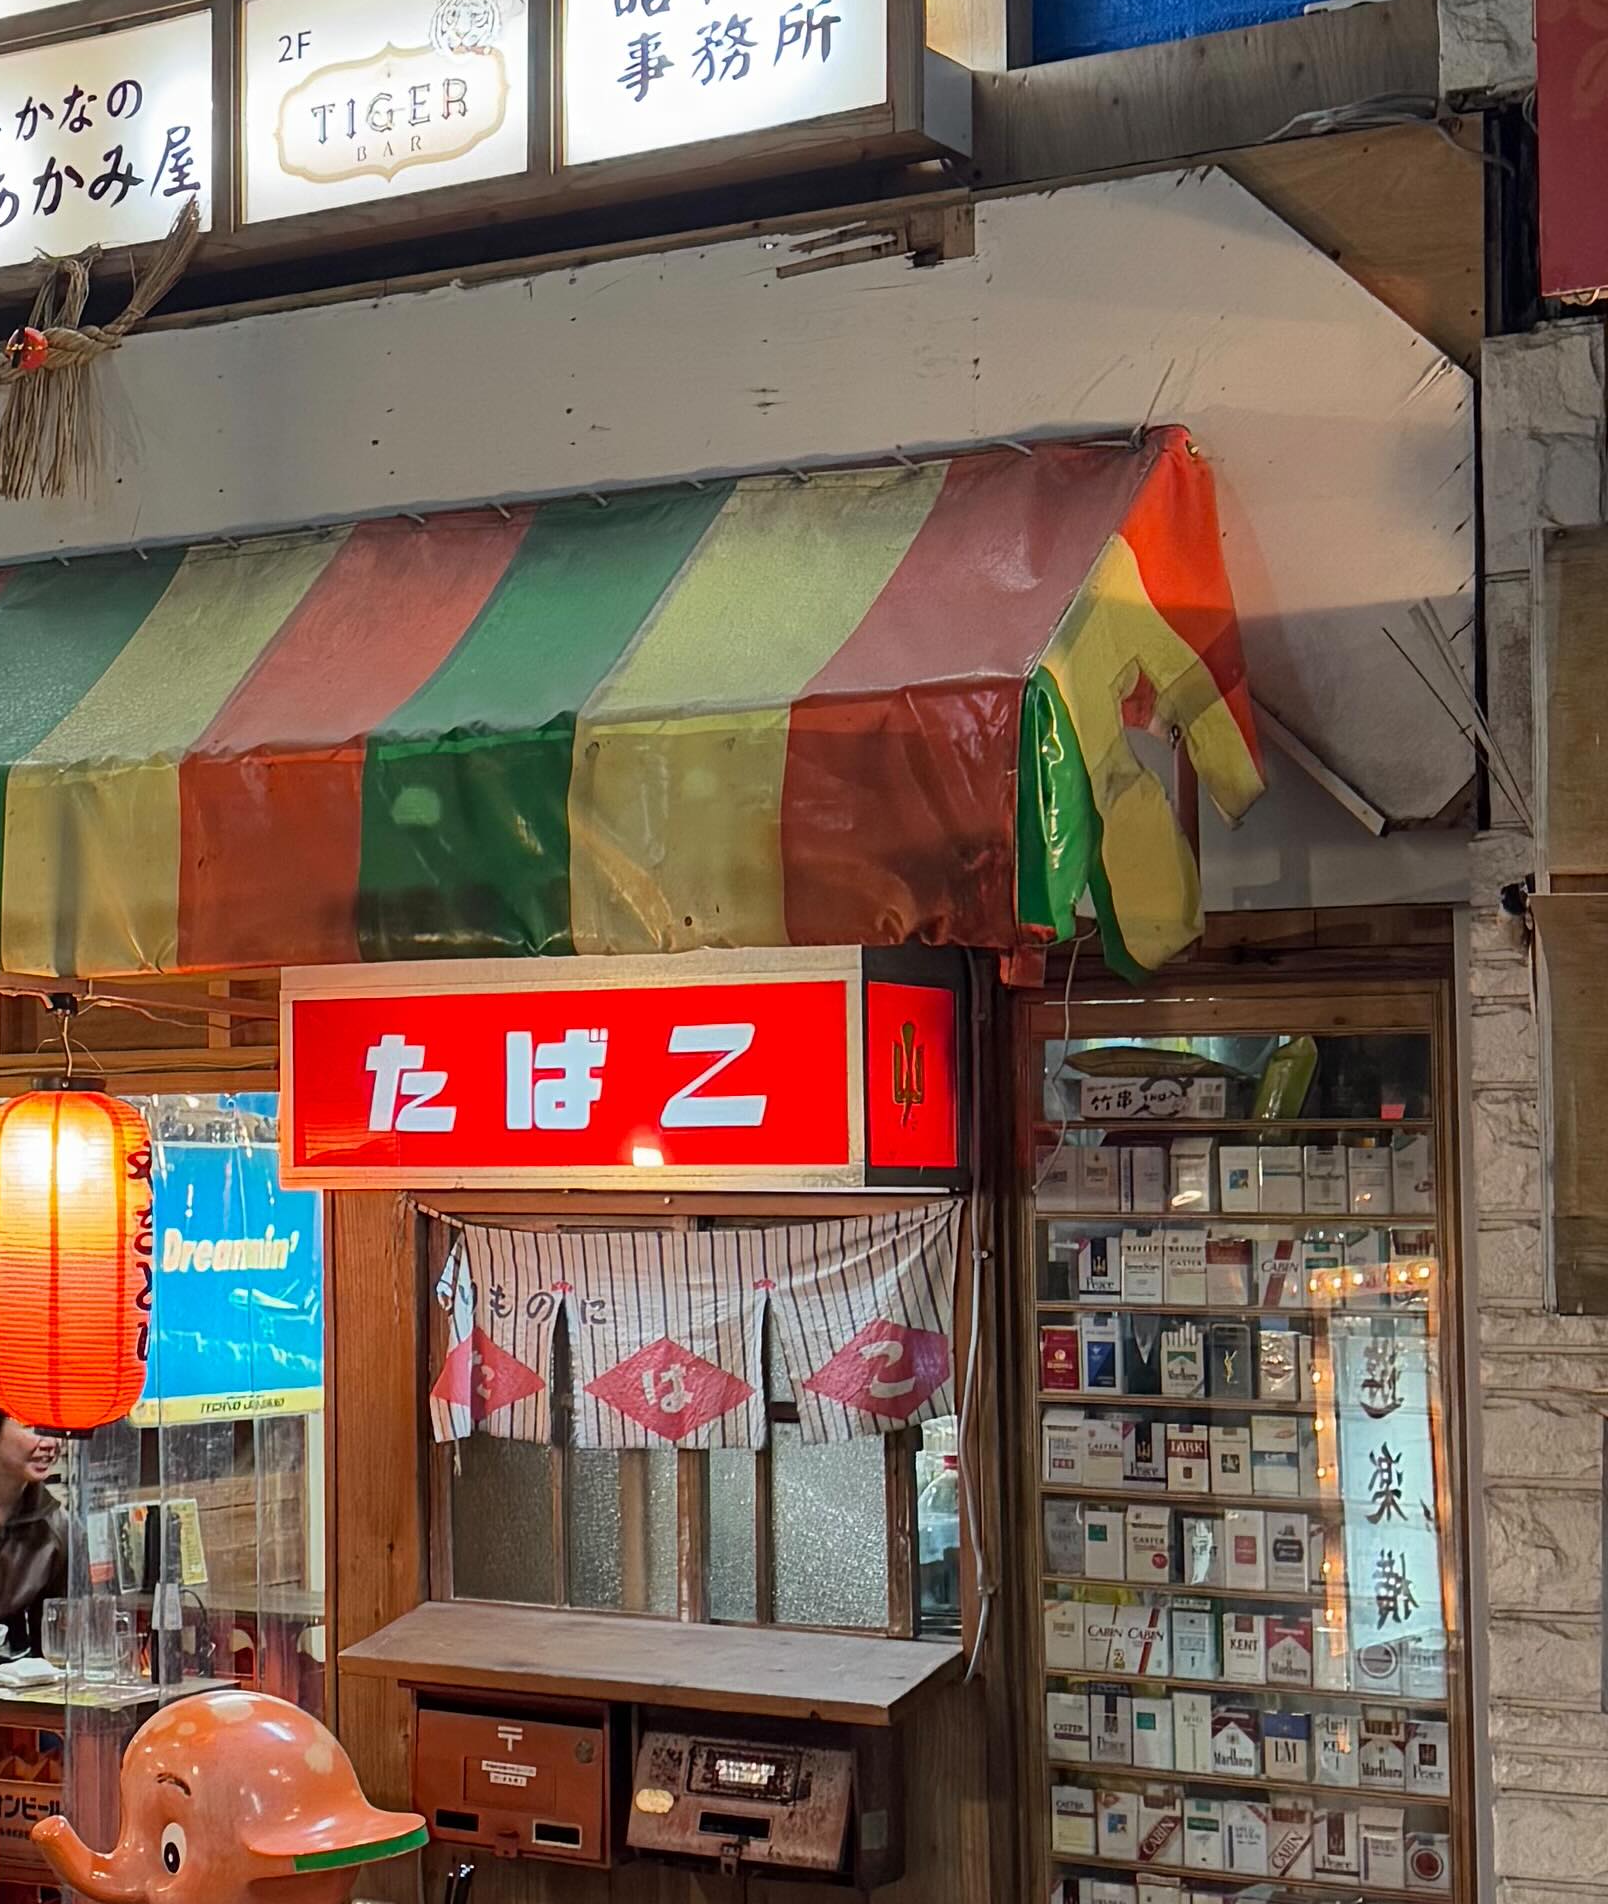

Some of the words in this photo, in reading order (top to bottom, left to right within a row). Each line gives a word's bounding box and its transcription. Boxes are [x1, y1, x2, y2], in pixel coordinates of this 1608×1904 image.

[277, 30, 313, 64] 2F
[310, 77, 470, 145] TIGER
[356, 134, 423, 164] BAR
[363, 1022, 768, 1134] たばこ
[1229, 1638, 1259, 1652] KENT
[1213, 1747, 1253, 1768] Marlboro
[1361, 1759, 1403, 1778] Marlboro
